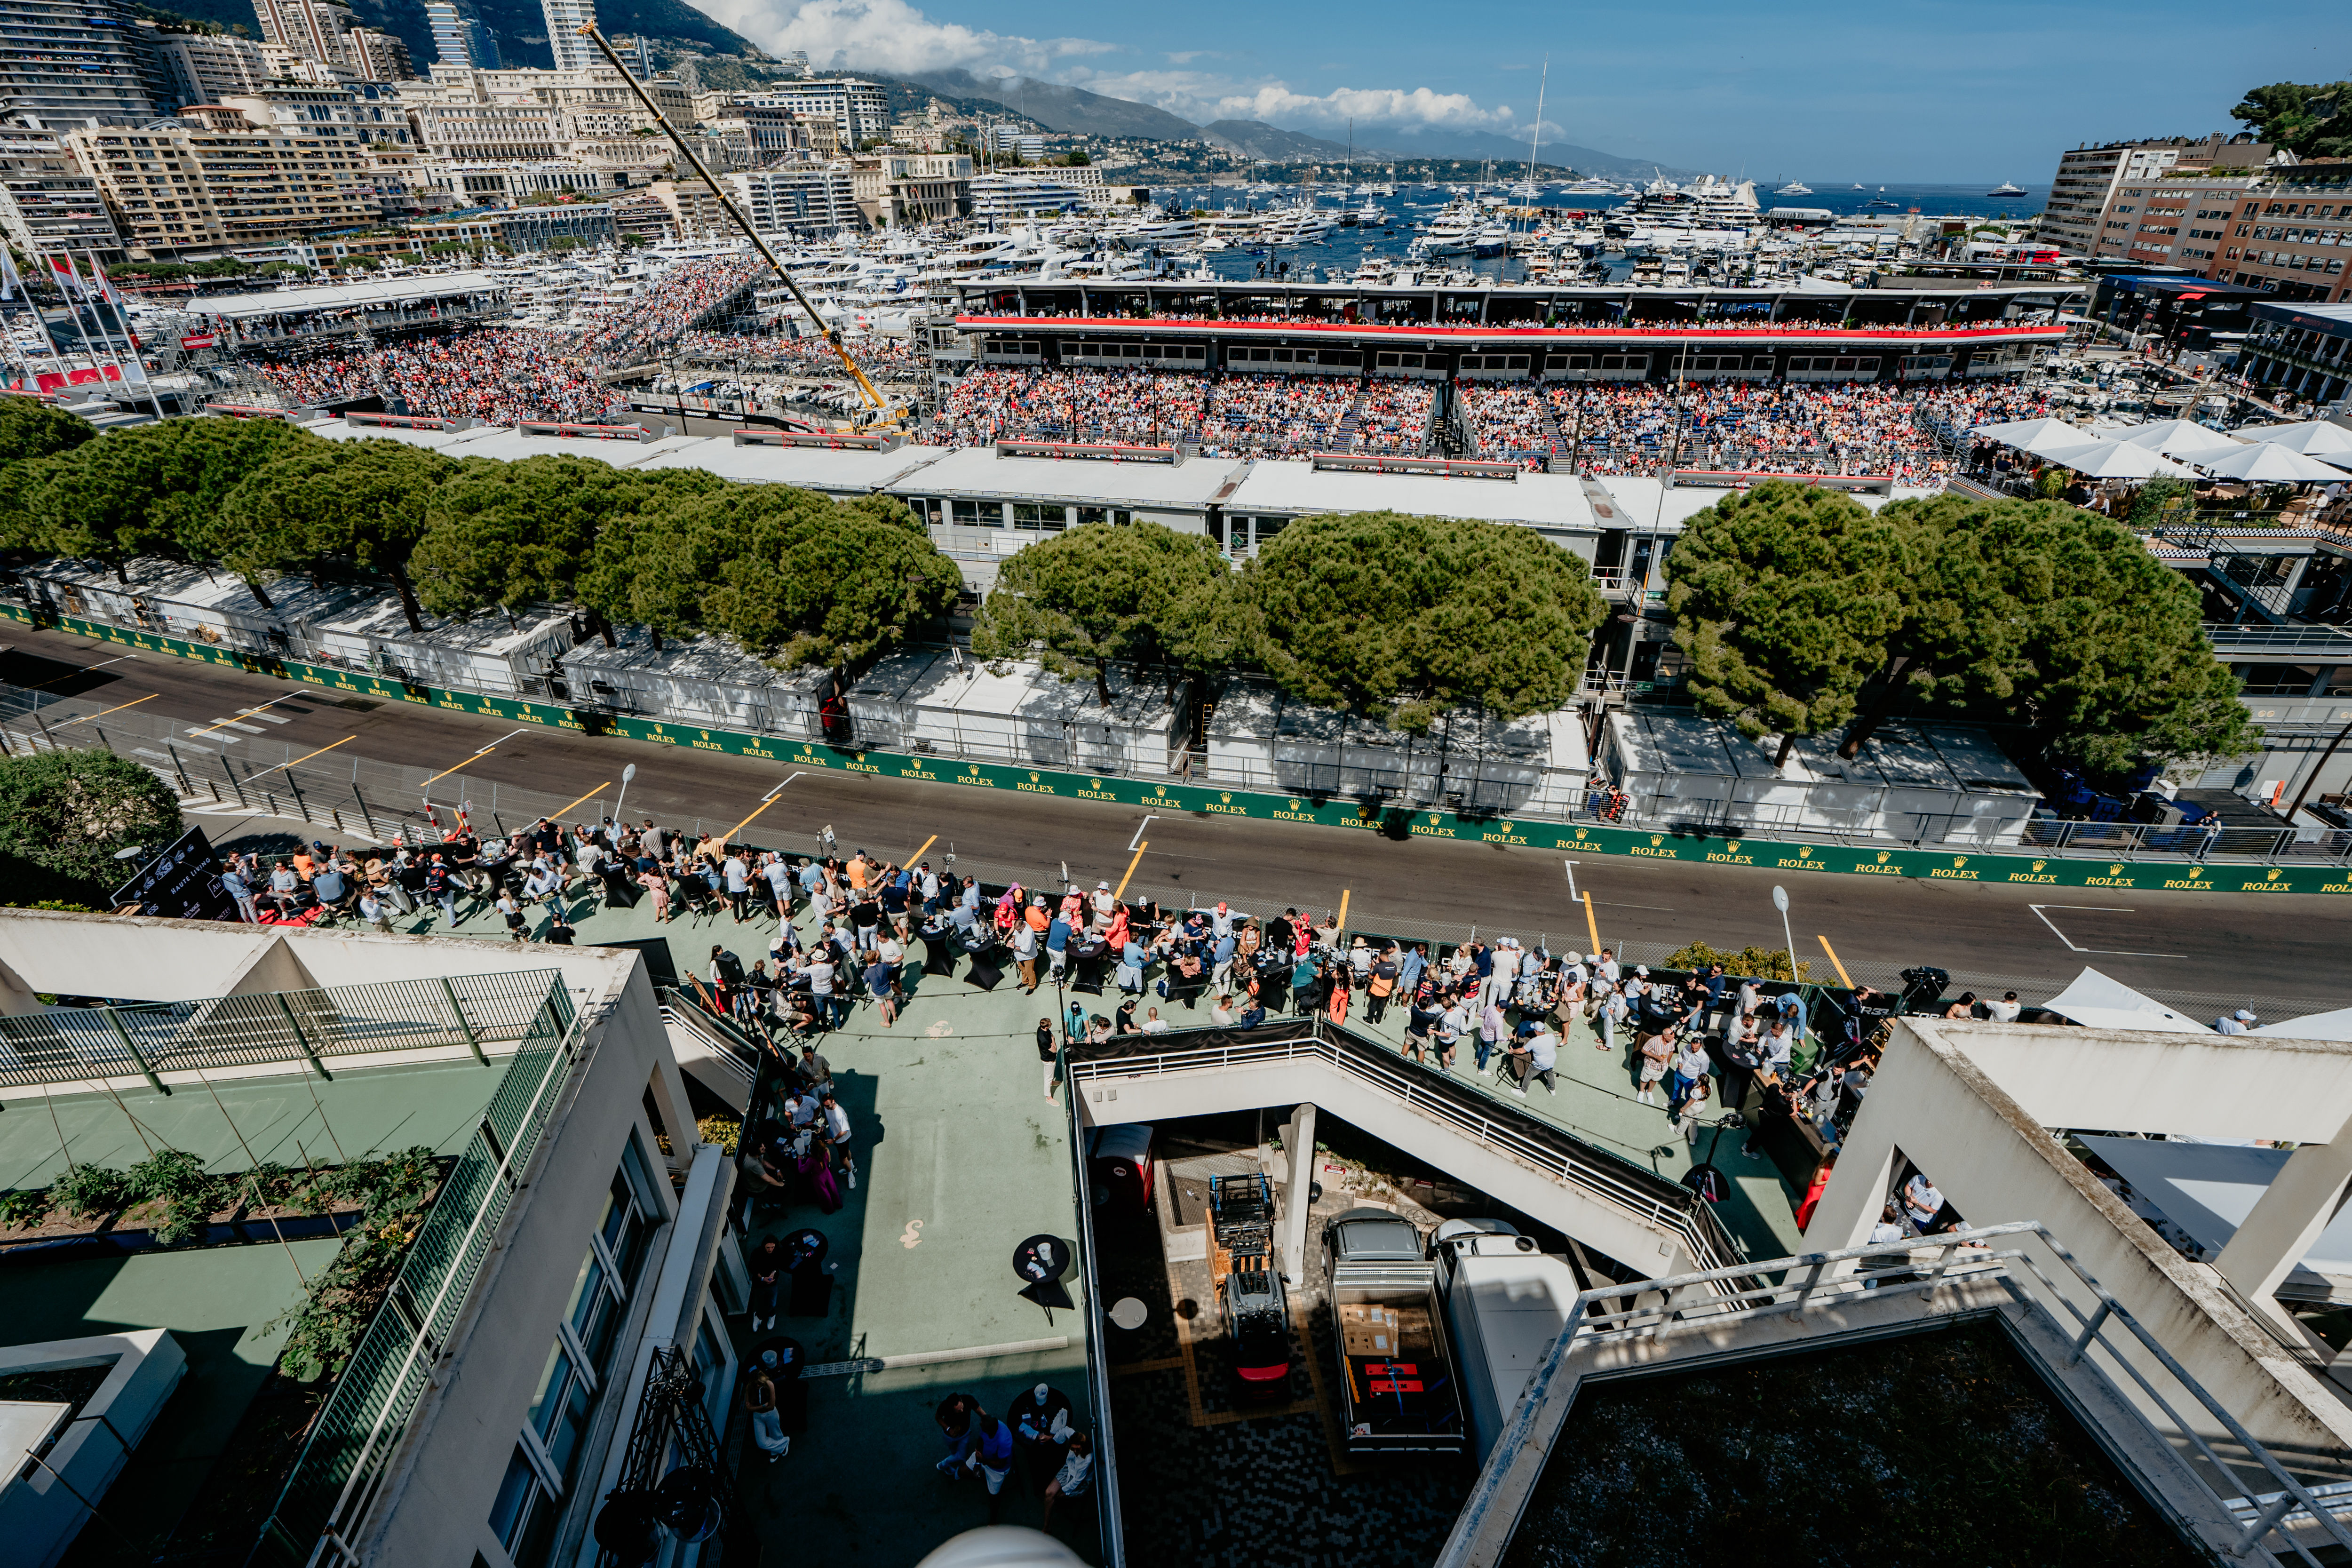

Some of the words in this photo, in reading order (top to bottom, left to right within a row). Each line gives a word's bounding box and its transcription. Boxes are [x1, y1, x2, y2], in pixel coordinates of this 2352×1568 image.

[853, 358, 875, 387] MEDIACO
[159, 646, 178, 655] ROLEX
[186, 652, 205, 661] ROLEX
[214, 658, 233, 667] ROLEX
[242, 663, 262, 672] ROLEX
[271, 669, 293, 678] ROLEX
[302, 675, 324, 685] ROLEX
[335, 681, 358, 691] ROLEX
[368, 688, 392, 697] ROLEX
[404, 694, 428, 704] ROLEX
[440, 700, 464, 710] ROLEX
[477, 707, 503, 716] ROLEX
[517, 713, 544, 723] ROLEX
[558, 720, 586, 730] ROLEX
[601, 726, 630, 737] ROLEX
[647, 733, 676, 744] ROLEX
[692, 740, 723, 750] ROLEX
[743, 747, 774, 758] ROLEX
[794, 754, 826, 765] ROLEX
[845, 762, 880, 773] ROLEX
[901, 769, 936, 780] ROLEX
[957, 775, 993, 786] ROLEX
[1017, 782, 1054, 793] ROLEX
[1078, 789, 1116, 800] ROLEX
[1141, 796, 1181, 808] ROLEX
[1206, 803, 1246, 815] ROLEX
[1273, 811, 1315, 822] ROLEX
[1341, 817, 1383, 829] ROLEX
[1411, 825, 1455, 836] ROLEX
[1483, 833, 1527, 844] ROLEX
[1556, 840, 1601, 851] ROLEX
[1630, 846, 1677, 858] ROLEX
[1706, 853, 1753, 864] ROLEX
[1778, 859, 1825, 870] ROLEX
[1855, 864, 1902, 874] ROLEX
[171, 876, 191, 894] HAUTE
[191, 858, 211, 876] LIVING
[1931, 868, 1980, 879] ROLEX
[2008, 873, 2058, 883] ROLEX
[2085, 876, 2134, 886] ROLEX
[2163, 880, 2213, 889] ROLEX
[2241, 882, 2292, 891] ROLEX
[212, 882, 221, 892] Au
